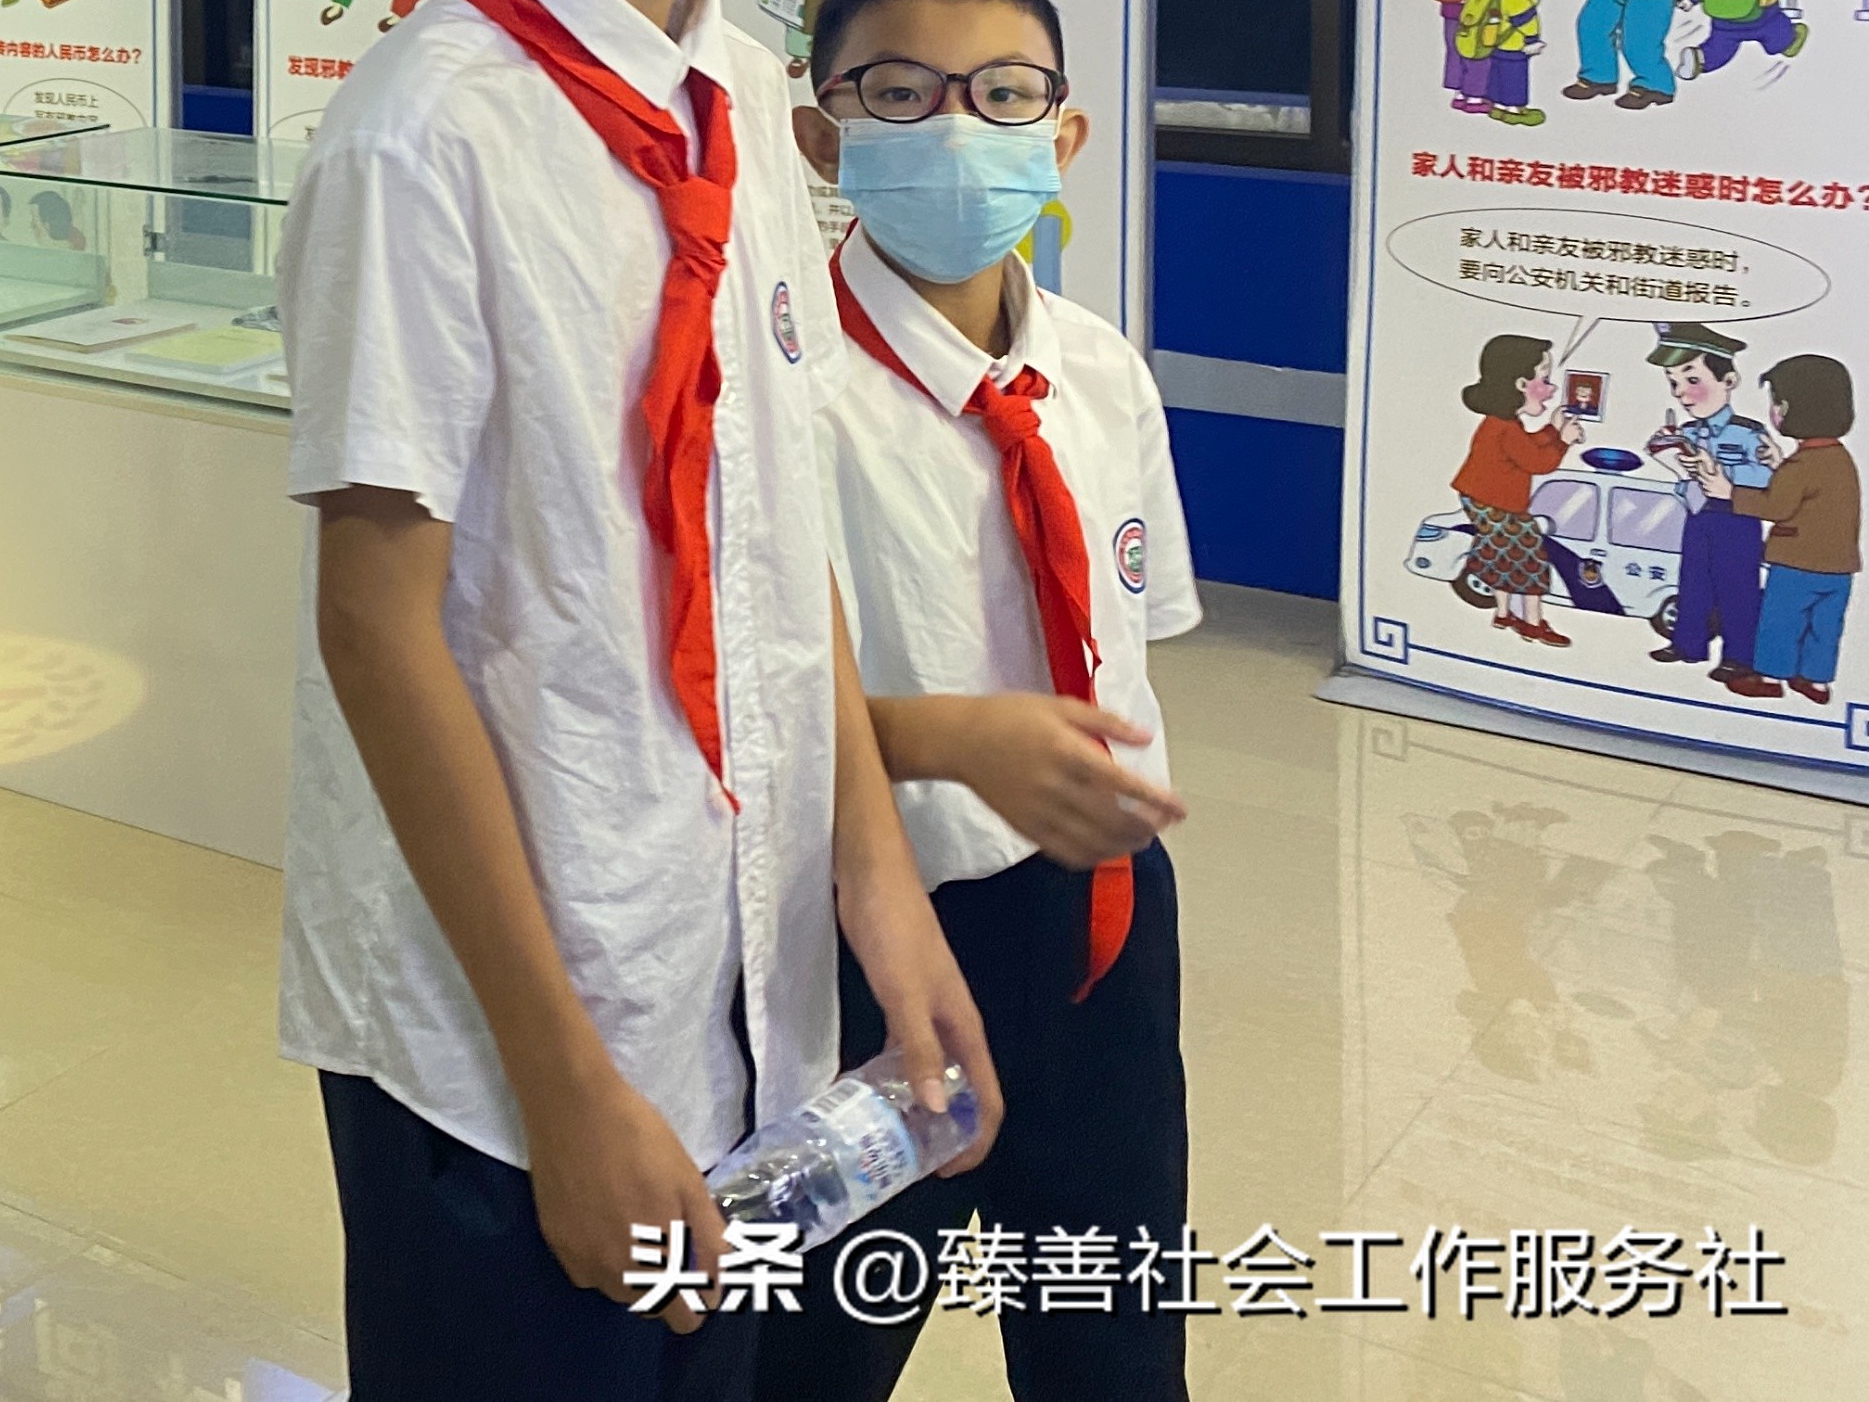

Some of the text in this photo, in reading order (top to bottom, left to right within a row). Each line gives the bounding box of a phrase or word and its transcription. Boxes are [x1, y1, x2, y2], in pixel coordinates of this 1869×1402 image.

[34, 91, 99, 109] 发现人民币上
[1460, 226, 1750, 274] 家人和亲友被邪教迷惑时，
[1459, 258, 1752, 308] 要向公安机关和街道报告。
[1624, 562, 1666, 581] 公安
